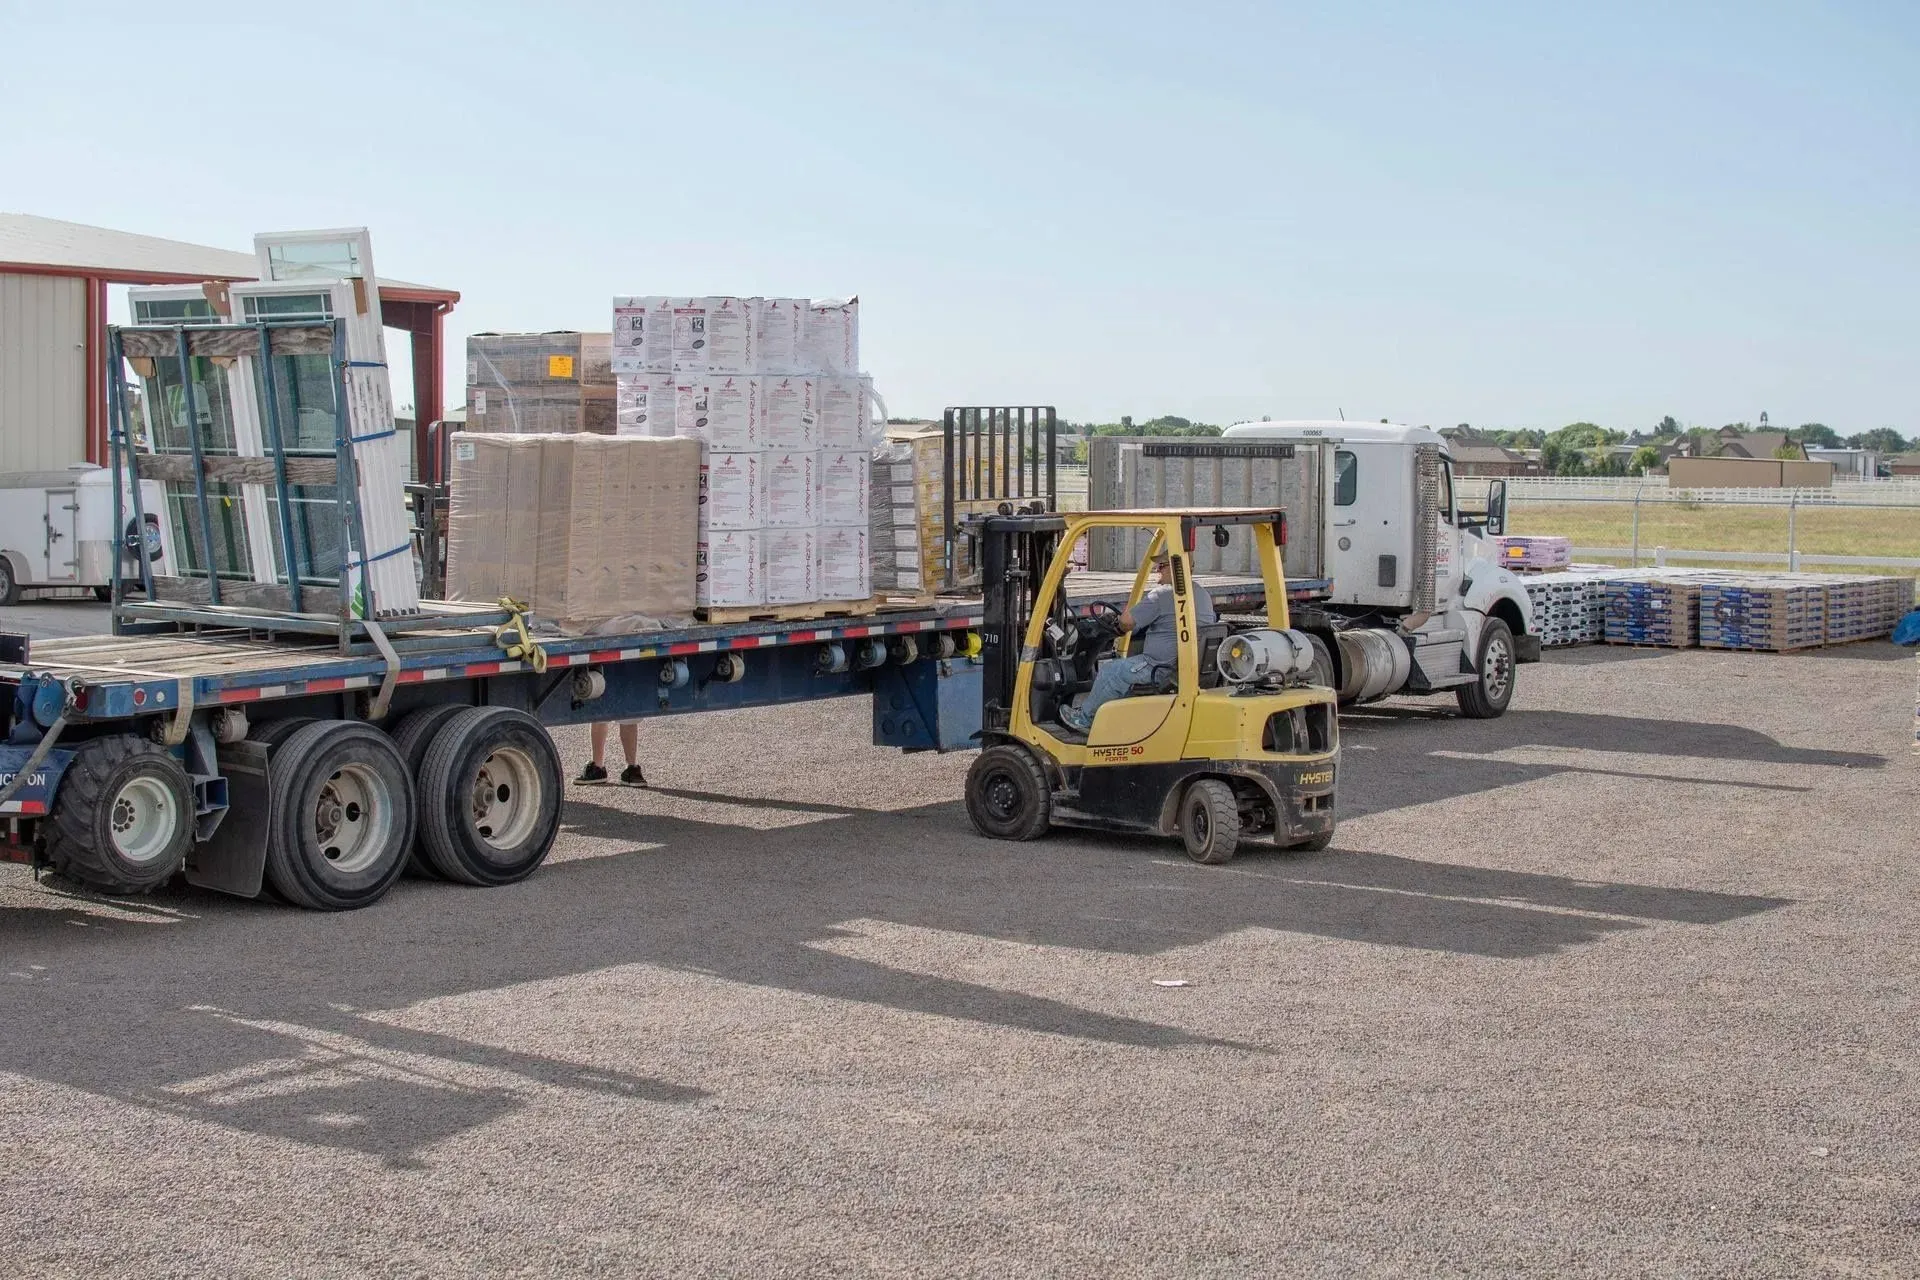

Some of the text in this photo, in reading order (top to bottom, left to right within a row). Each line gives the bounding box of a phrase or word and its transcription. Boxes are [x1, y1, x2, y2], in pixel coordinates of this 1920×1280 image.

[1177, 600, 1189, 643] 710
[984, 633, 999, 644] 710
[1093, 746, 1144, 758] HYSTER 50
